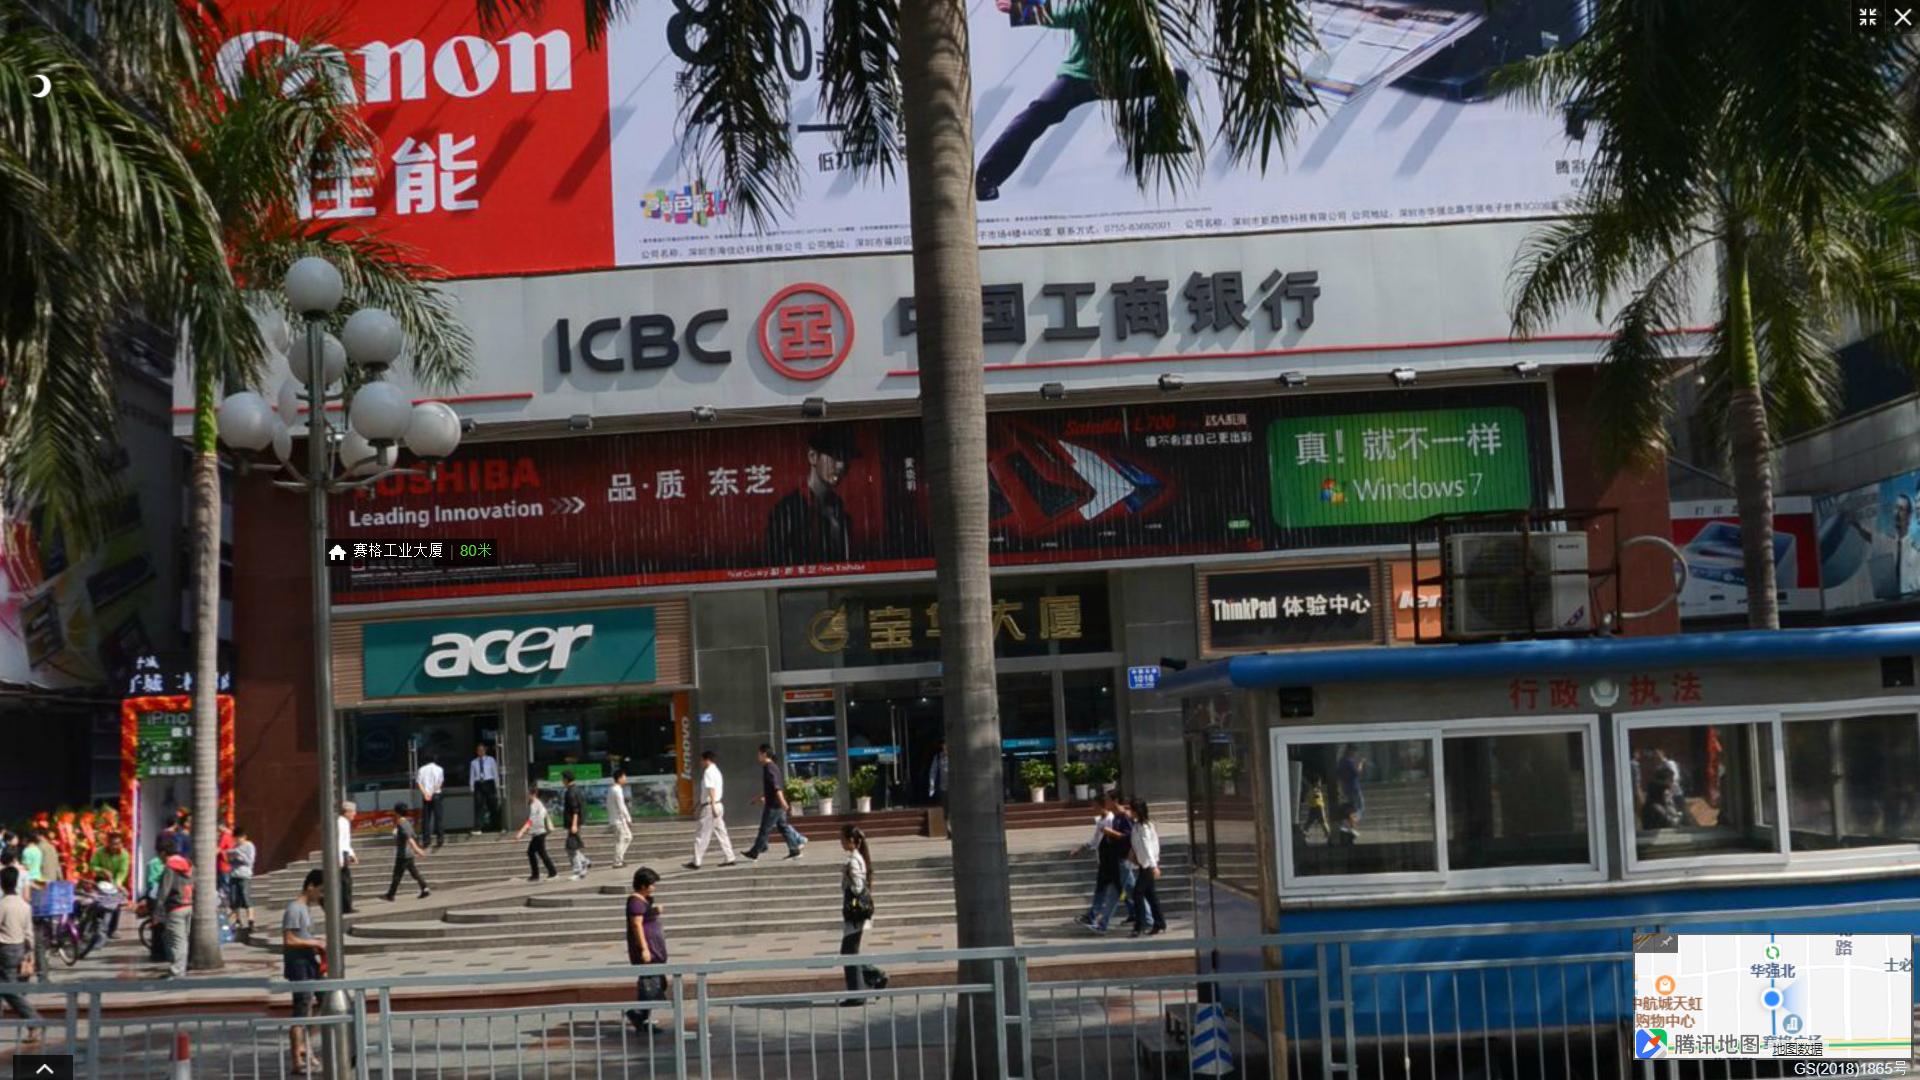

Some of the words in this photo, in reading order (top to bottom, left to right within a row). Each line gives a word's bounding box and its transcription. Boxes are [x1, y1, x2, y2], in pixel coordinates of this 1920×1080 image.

[214, 29, 572, 105] Canon
[290, 134, 479, 219] 佳能
[556, 308, 732, 374] ICBC
[354, 456, 543, 499] OSHIBA
[708, 464, 774, 496] 东芝
[1353, 477, 1465, 503] Windows
[1469, 472, 1484, 497] 7
[349, 506, 430, 529] Leading
[435, 500, 544, 524] Innovation
[1212, 597, 1277, 621] ThinkPad
[1282, 594, 1370, 617] 体验中心
[424, 624, 594, 678] acer
[1509, 679, 1580, 710] 行政
[1628, 672, 1703, 706] 执法
